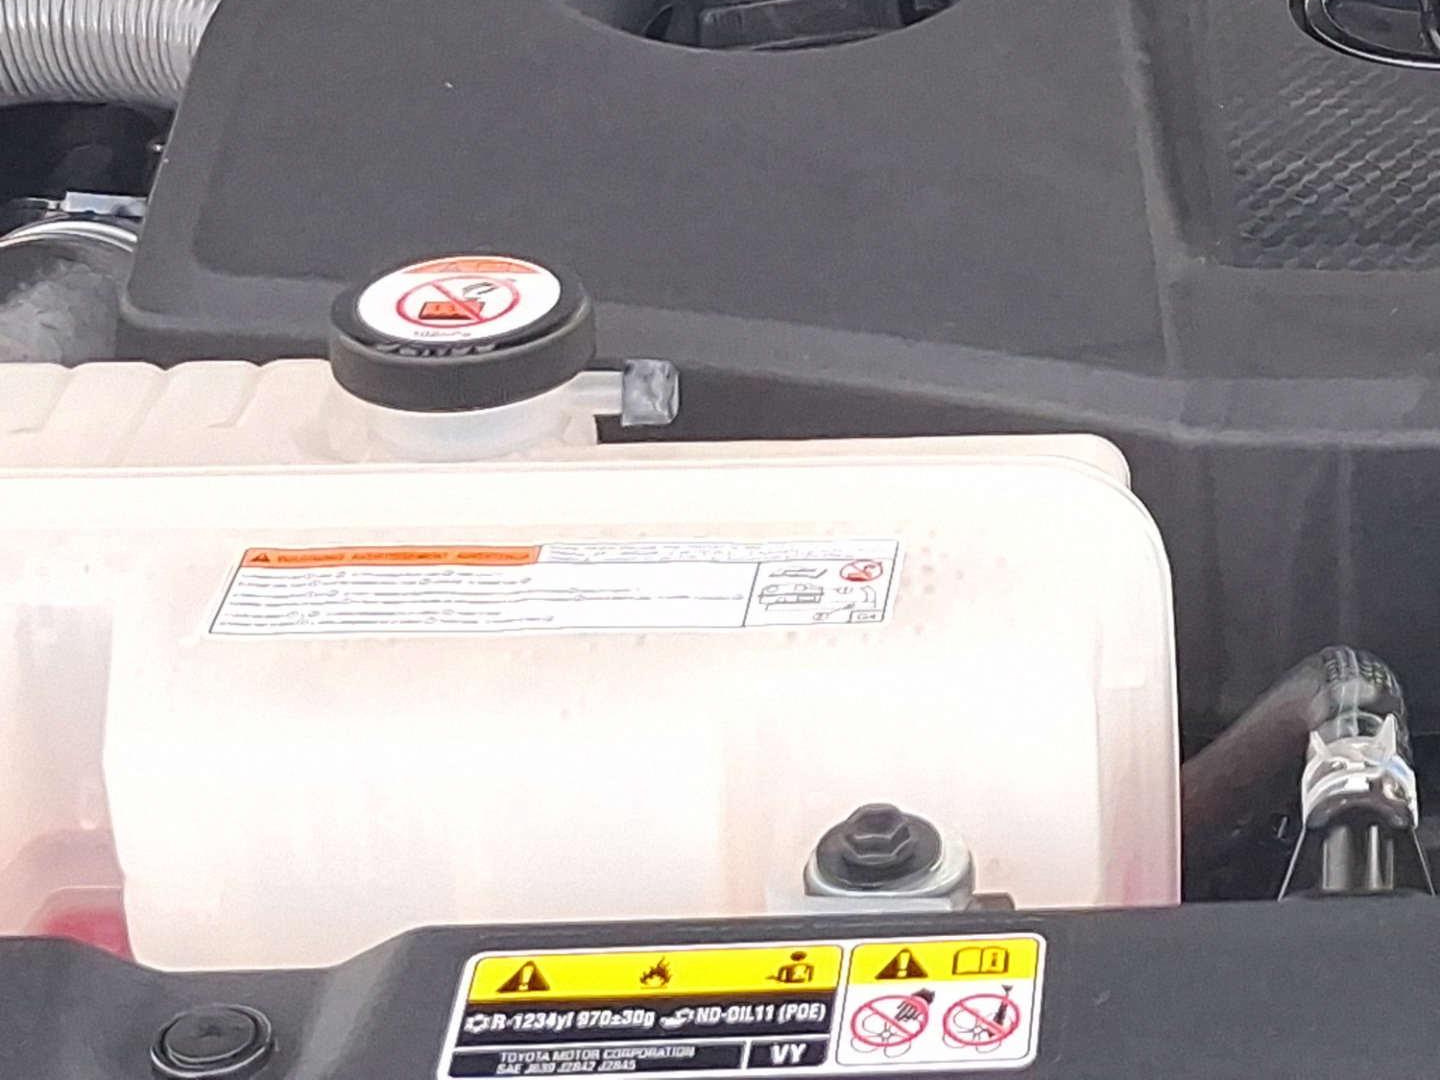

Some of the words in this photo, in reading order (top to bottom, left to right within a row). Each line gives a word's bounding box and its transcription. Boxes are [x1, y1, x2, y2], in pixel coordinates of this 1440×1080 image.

[500, 1051, 550, 1063] TOYOTA
[552, 1048, 600, 1061] MOTOR
[602, 1046, 695, 1060] CORPORATION
[771, 1043, 806, 1066] VY
[496, 1063, 523, 1075] SAE
